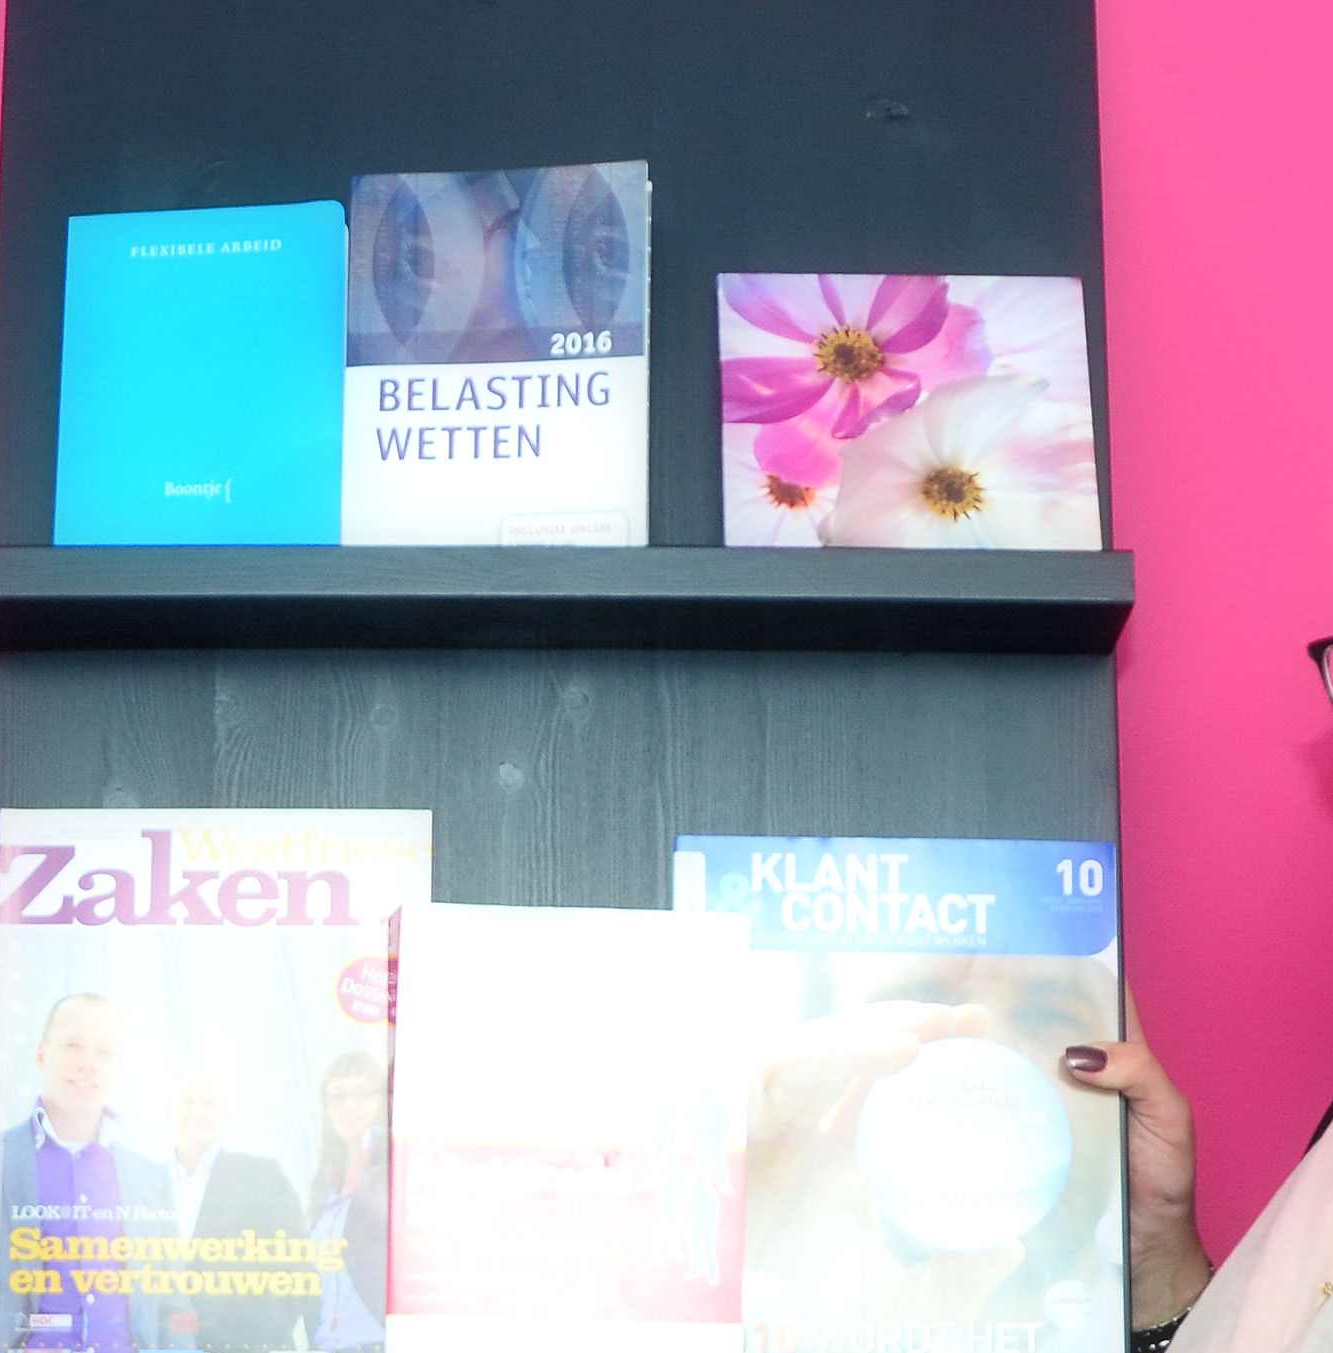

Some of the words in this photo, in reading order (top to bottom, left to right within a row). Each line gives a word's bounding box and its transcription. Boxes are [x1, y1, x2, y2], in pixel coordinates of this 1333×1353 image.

[130, 240, 216, 258] FLEXIBELE
[221, 238, 283, 254] ARBEID
[549, 331, 613, 355] 2016
[378, 371, 611, 412] BELASTING
[376, 424, 542, 461] WETTEN
[752, 852, 908, 893] KLANT
[1055, 858, 1103, 896] 10
[781, 894, 995, 934] CONTACT
[9, 1226, 348, 1271] Samenwerking
[9, 1269, 62, 1295] en
[71, 1262, 323, 1296] vertrouwen
